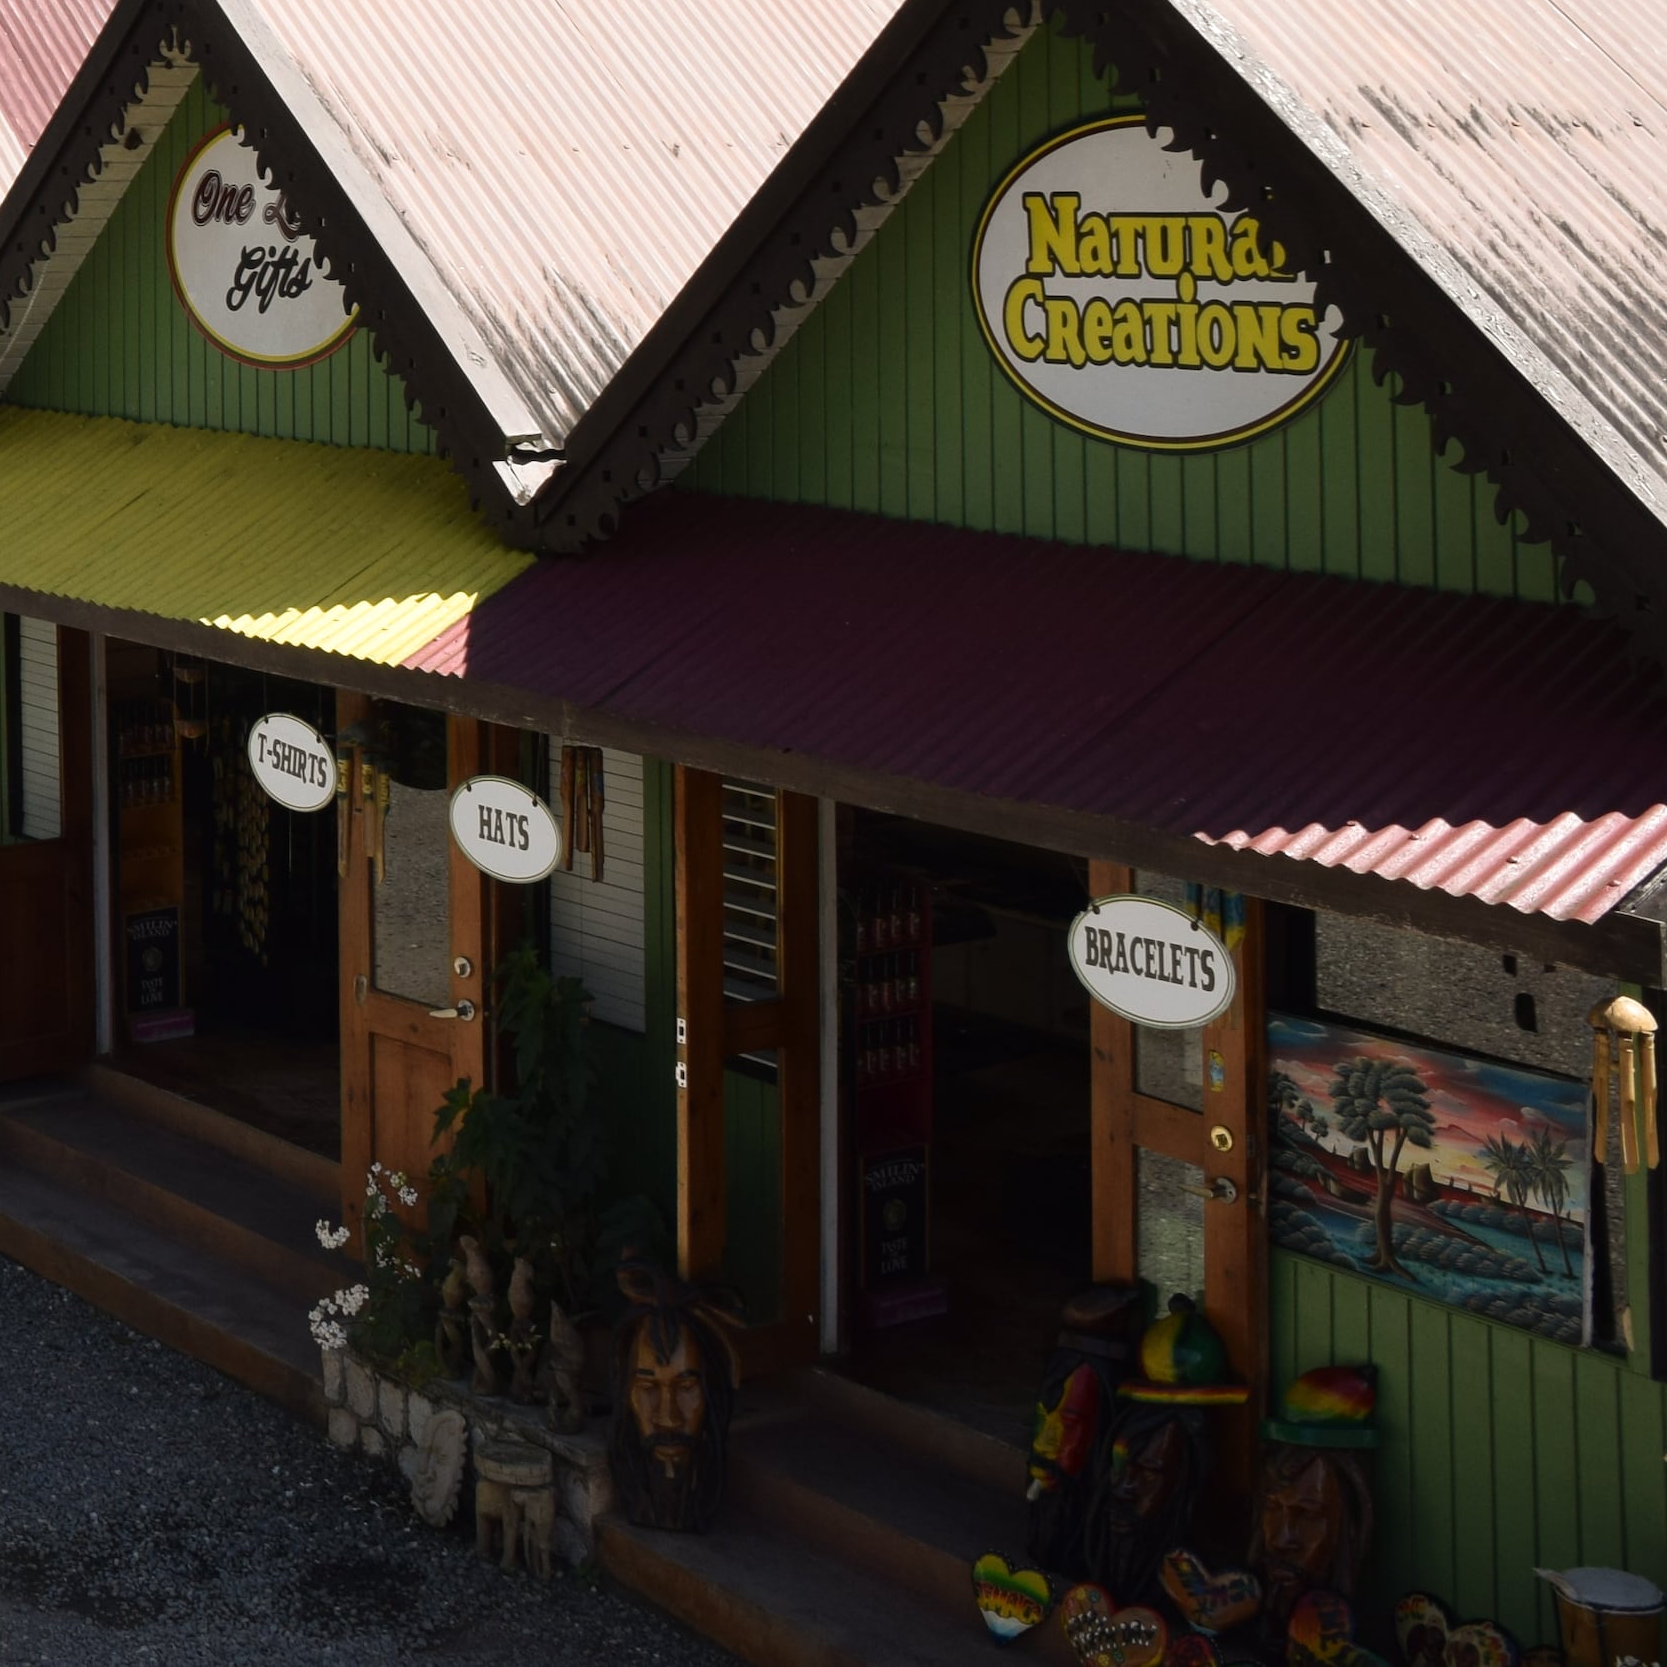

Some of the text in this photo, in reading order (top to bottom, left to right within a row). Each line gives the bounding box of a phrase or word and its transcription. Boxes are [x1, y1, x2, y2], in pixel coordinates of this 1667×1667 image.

[192, 168, 256, 227] One
[226, 245, 312, 314] Gifts
[257, 732, 328, 788] T-SHIRTS
[478, 804, 530, 851] HATS
[1084, 925, 1216, 992] BRACELETS
